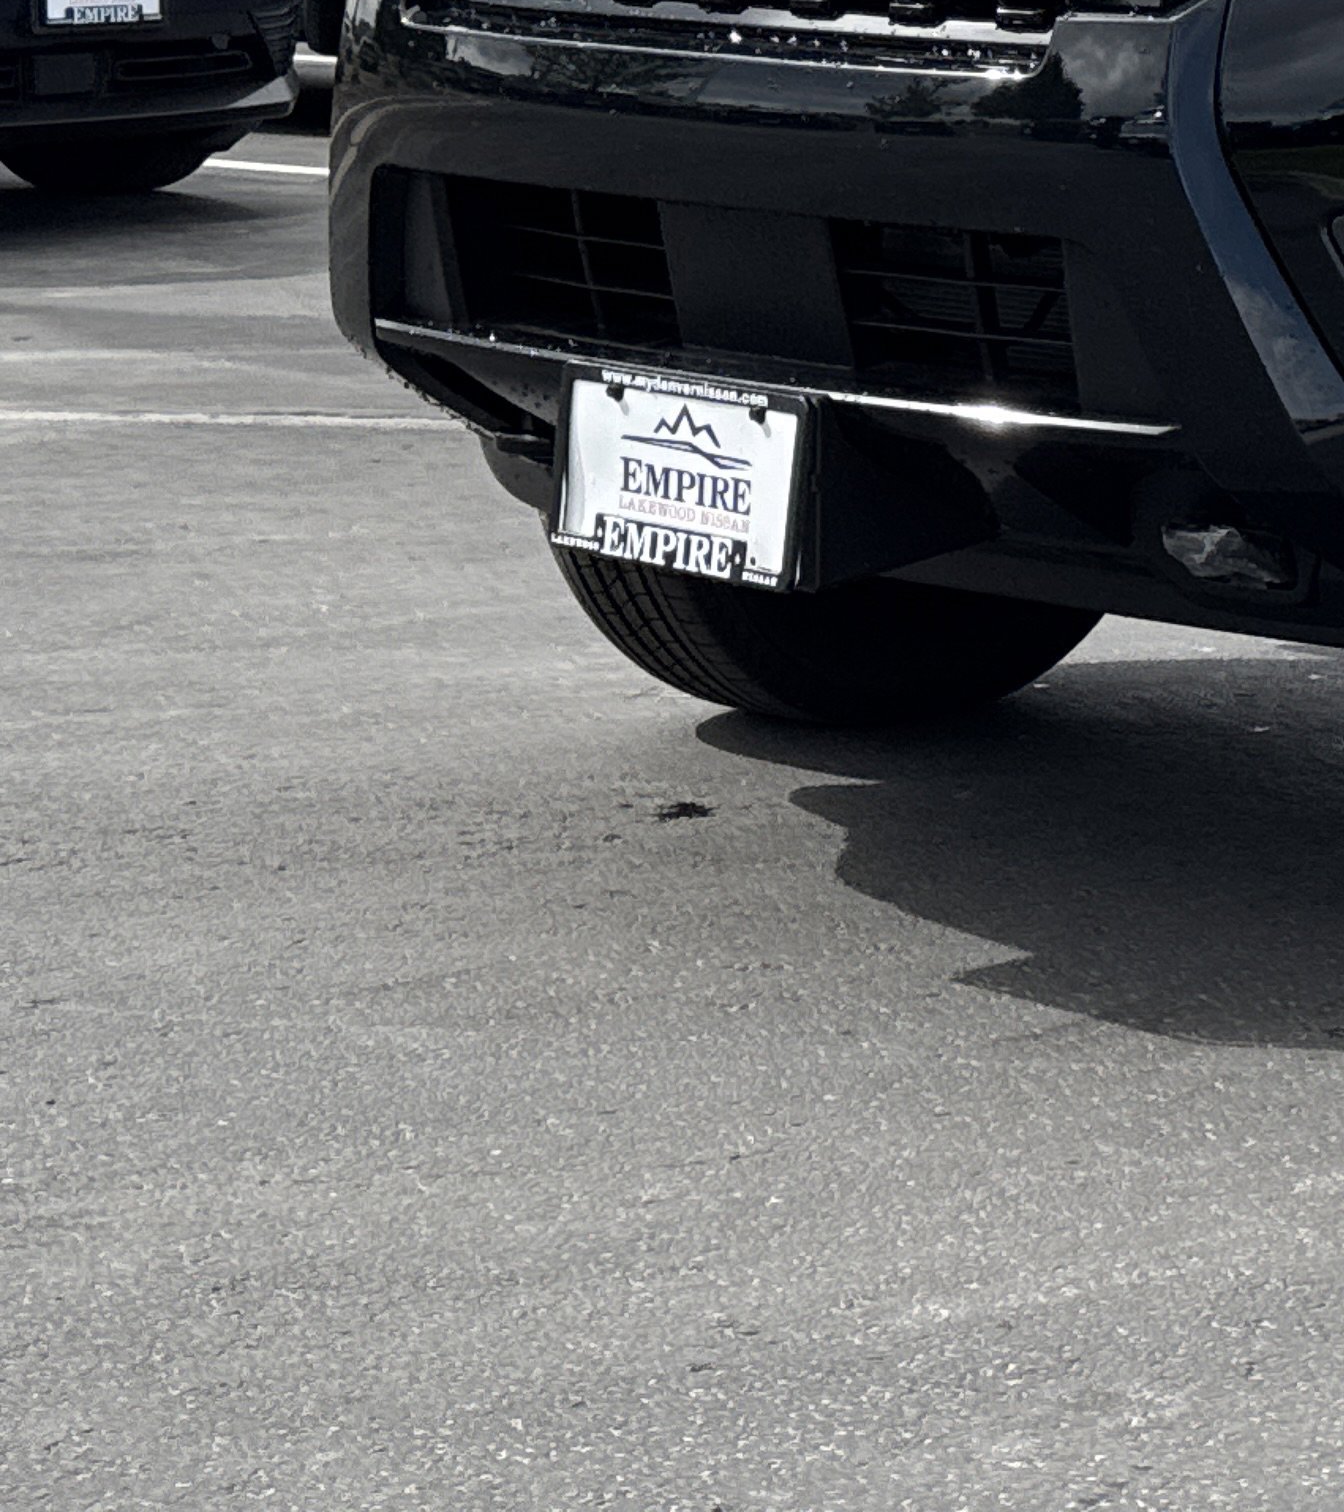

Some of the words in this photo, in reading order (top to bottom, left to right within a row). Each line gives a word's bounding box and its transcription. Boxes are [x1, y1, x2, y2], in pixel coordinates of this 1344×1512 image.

[73, 5, 139, 25] EMPIRE
[619, 456, 752, 516] EMPIRE
[618, 494, 696, 522] LAKEWOOD
[700, 510, 751, 534] NISSAN
[600, 516, 733, 579] EMPIRE
